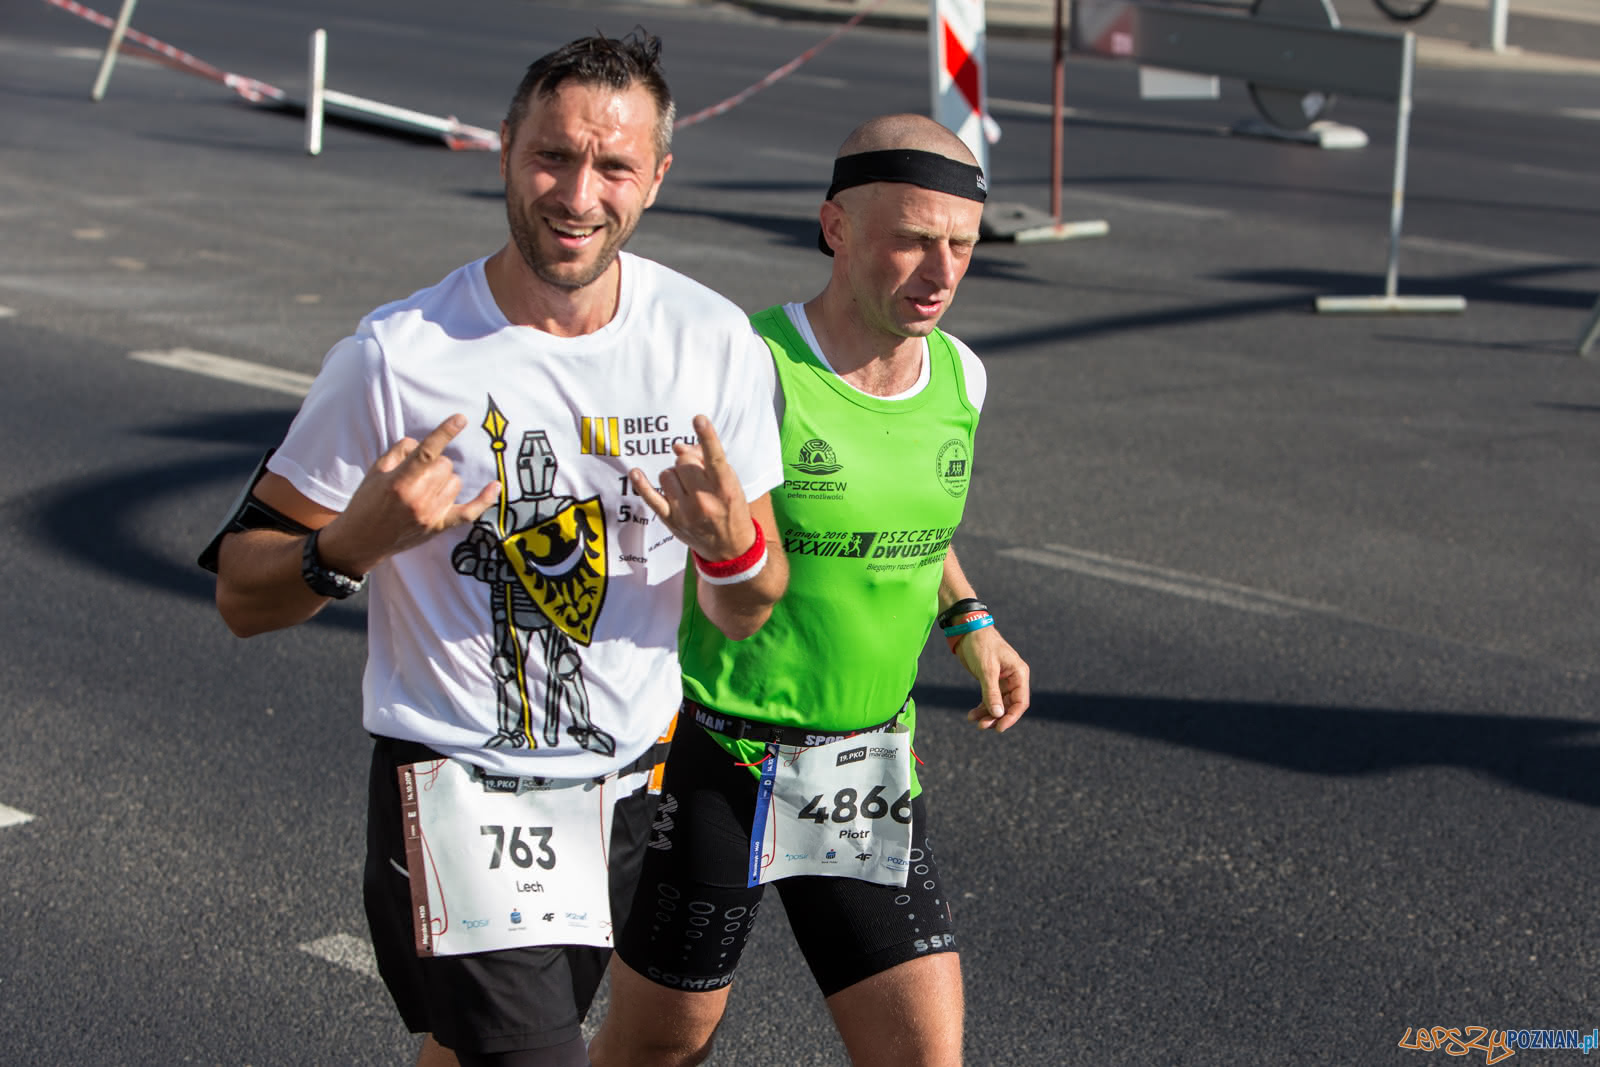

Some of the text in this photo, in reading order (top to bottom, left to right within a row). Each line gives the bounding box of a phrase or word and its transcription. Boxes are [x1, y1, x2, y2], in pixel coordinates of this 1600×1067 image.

[623, 415, 669, 434] BIEG
[783, 480, 848, 492] PSZCZEW
[794, 530, 820, 540] maja
[822, 531, 849, 541] 2016
[797, 785, 912, 824] 4866
[838, 829, 870, 839] Piotr
[479, 825, 556, 871] 763
[515, 879, 545, 893] Lech
